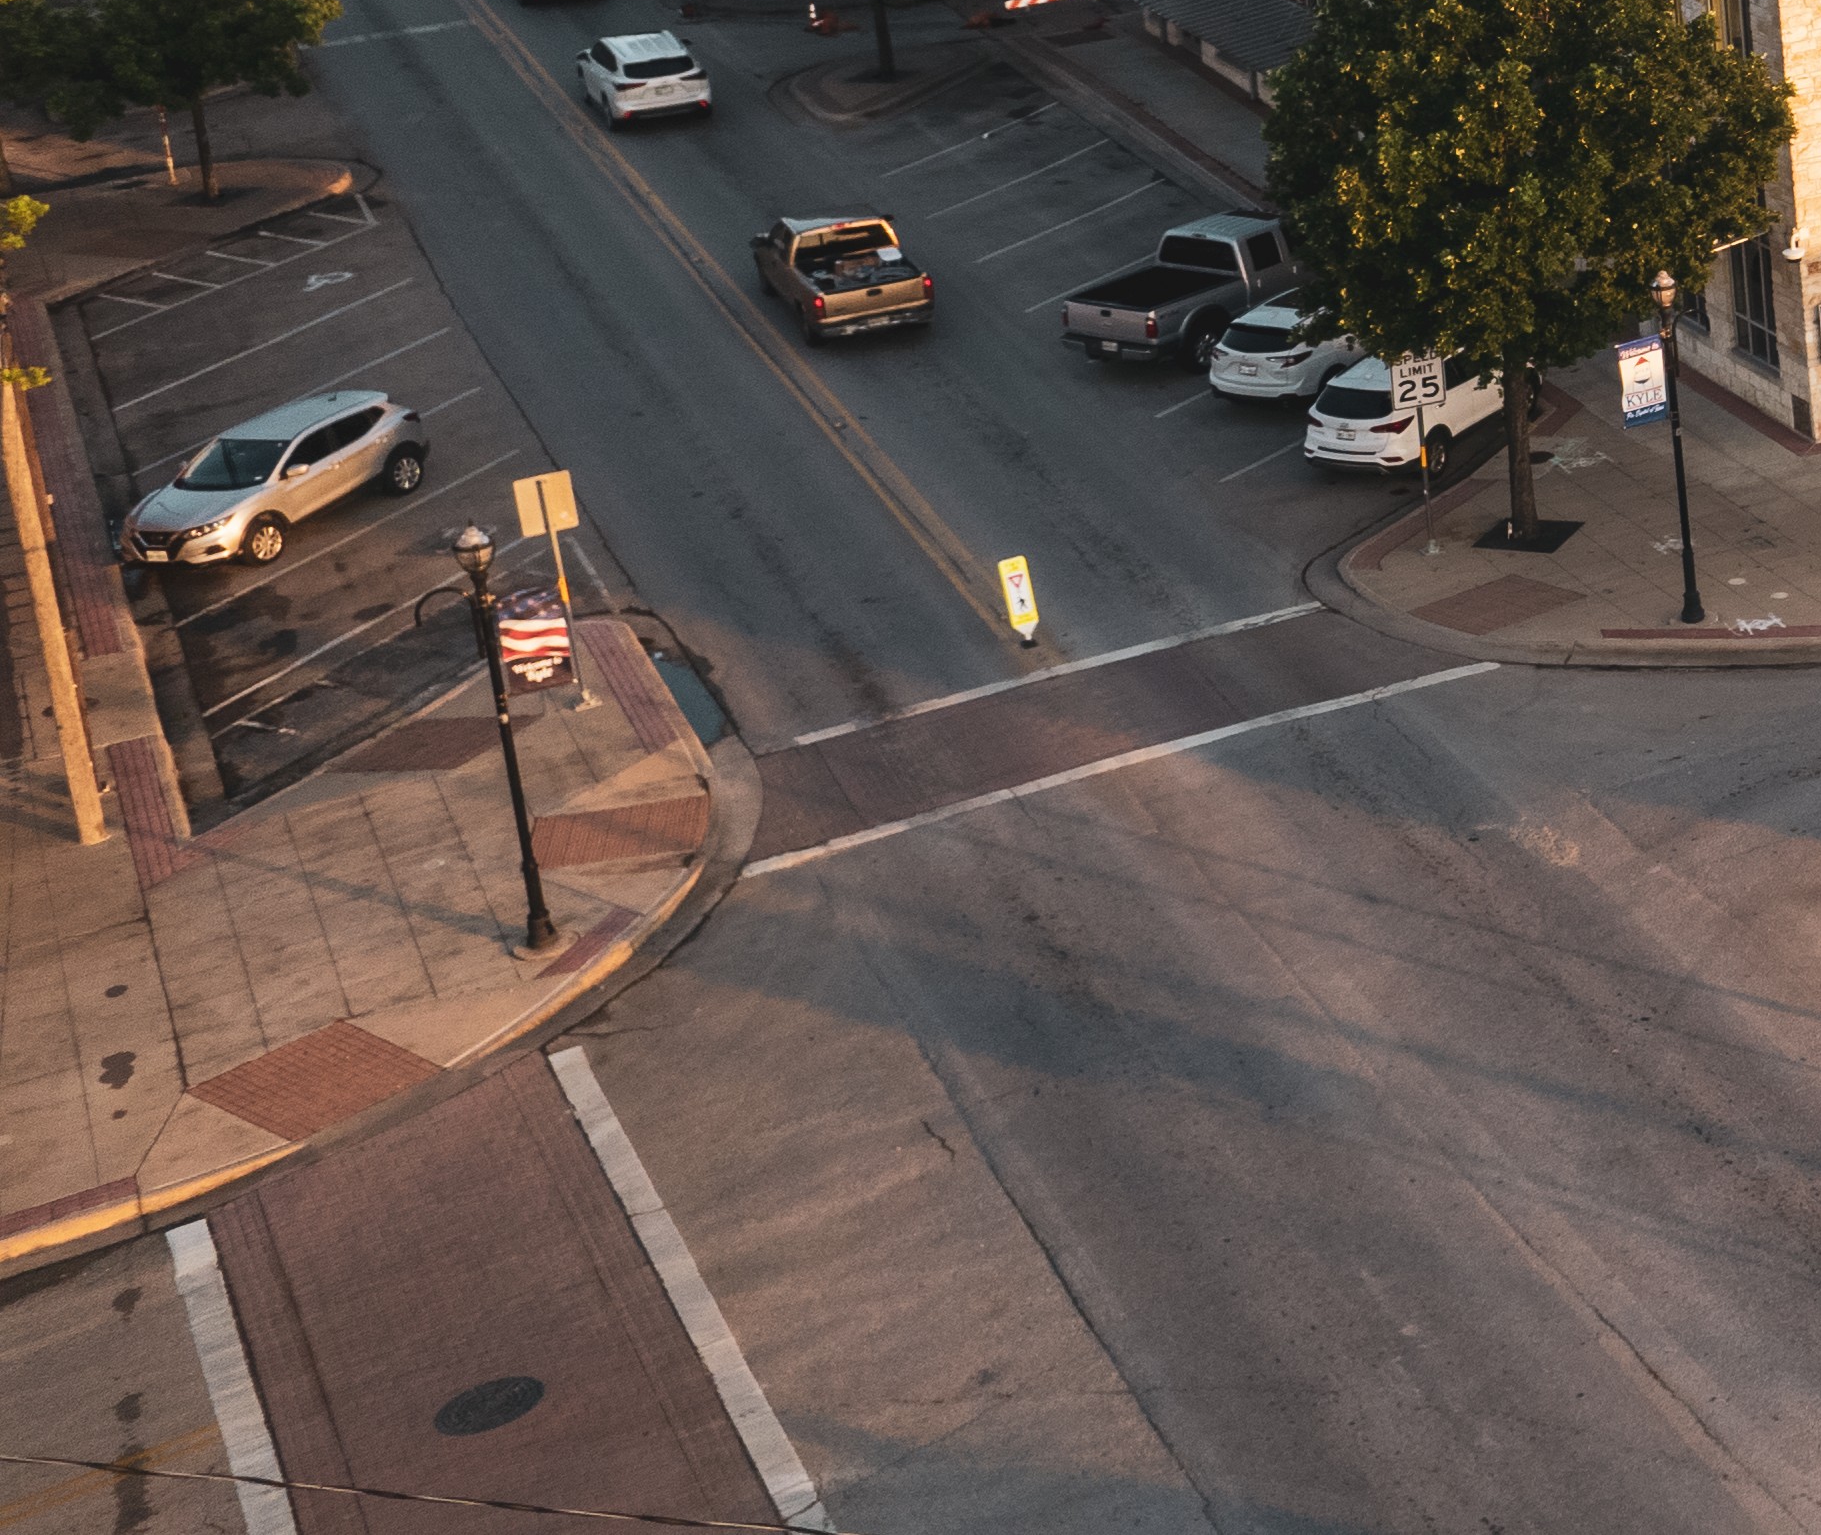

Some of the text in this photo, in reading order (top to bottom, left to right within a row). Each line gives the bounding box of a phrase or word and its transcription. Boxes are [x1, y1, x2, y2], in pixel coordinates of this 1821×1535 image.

[1400, 363, 1434, 378] LIMIT
[1398, 375, 1440, 403] 25
[1626, 388, 1663, 407] KYLE
[511, 656, 563, 674] Welcome to
[525, 667, 554, 682] Kyle
